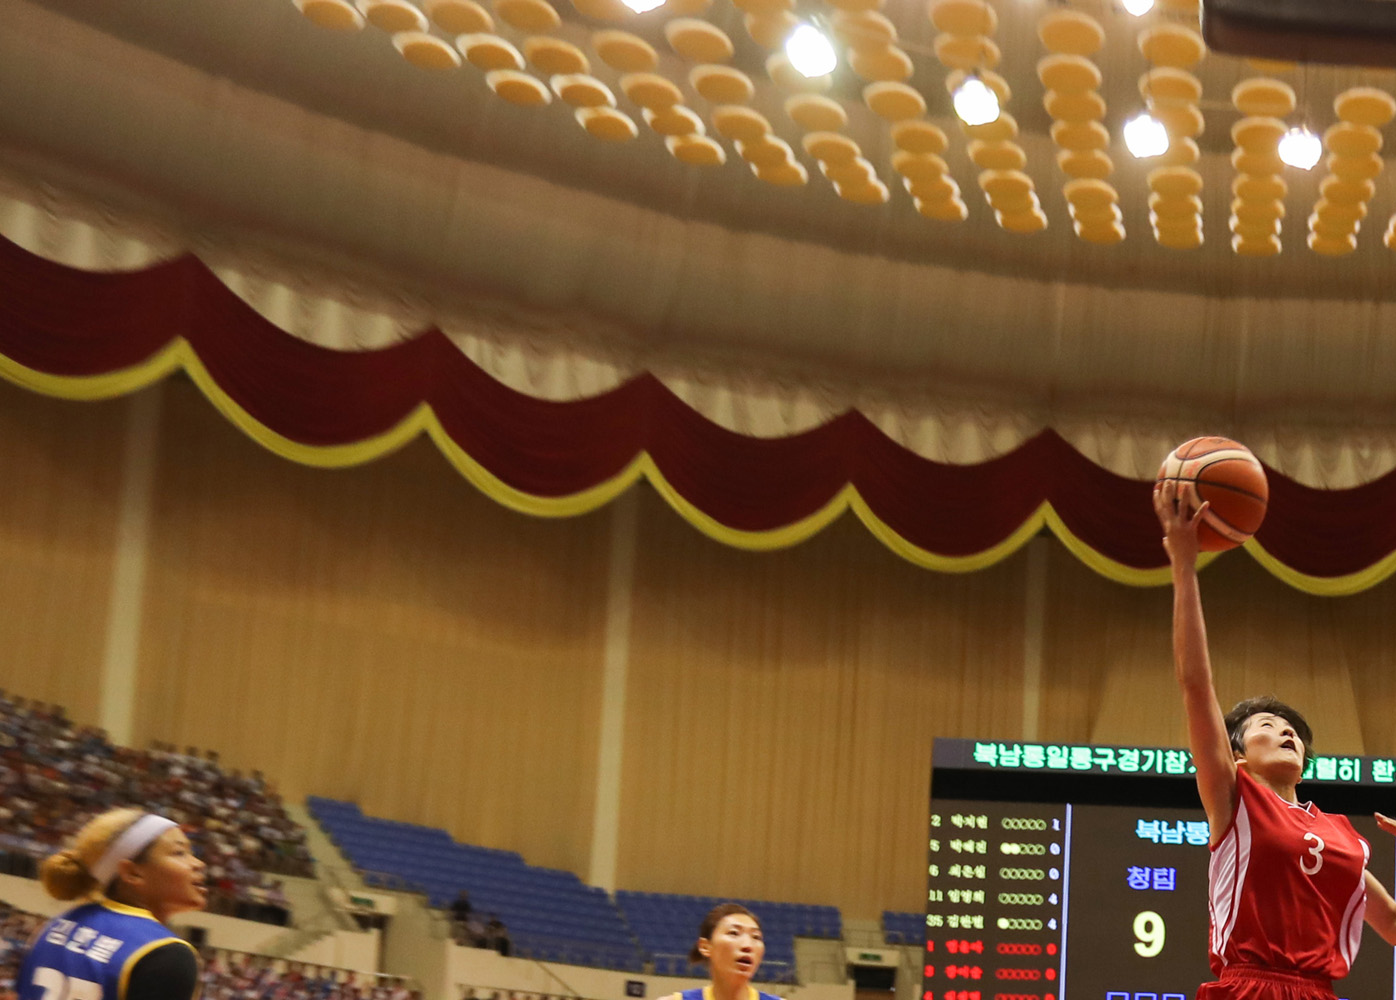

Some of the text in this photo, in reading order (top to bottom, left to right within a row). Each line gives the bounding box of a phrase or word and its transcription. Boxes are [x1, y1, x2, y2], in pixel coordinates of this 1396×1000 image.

[973, 742, 1197, 774] 북남통일롱구경기참
[930, 814, 942, 827] 2
[929, 839, 940, 852] 5
[1049, 842, 1061, 855] 0
[1299, 831, 1327, 876] 3
[928, 864, 940, 877] 6
[1048, 867, 1060, 880] 0
[1126, 866, 1177, 891] 청팀
[928, 889, 944, 902] 11
[1048, 892, 1059, 905] 4
[925, 913, 944, 928] 35
[1047, 917, 1058, 931] 4
[1132, 910, 1166, 958] 9
